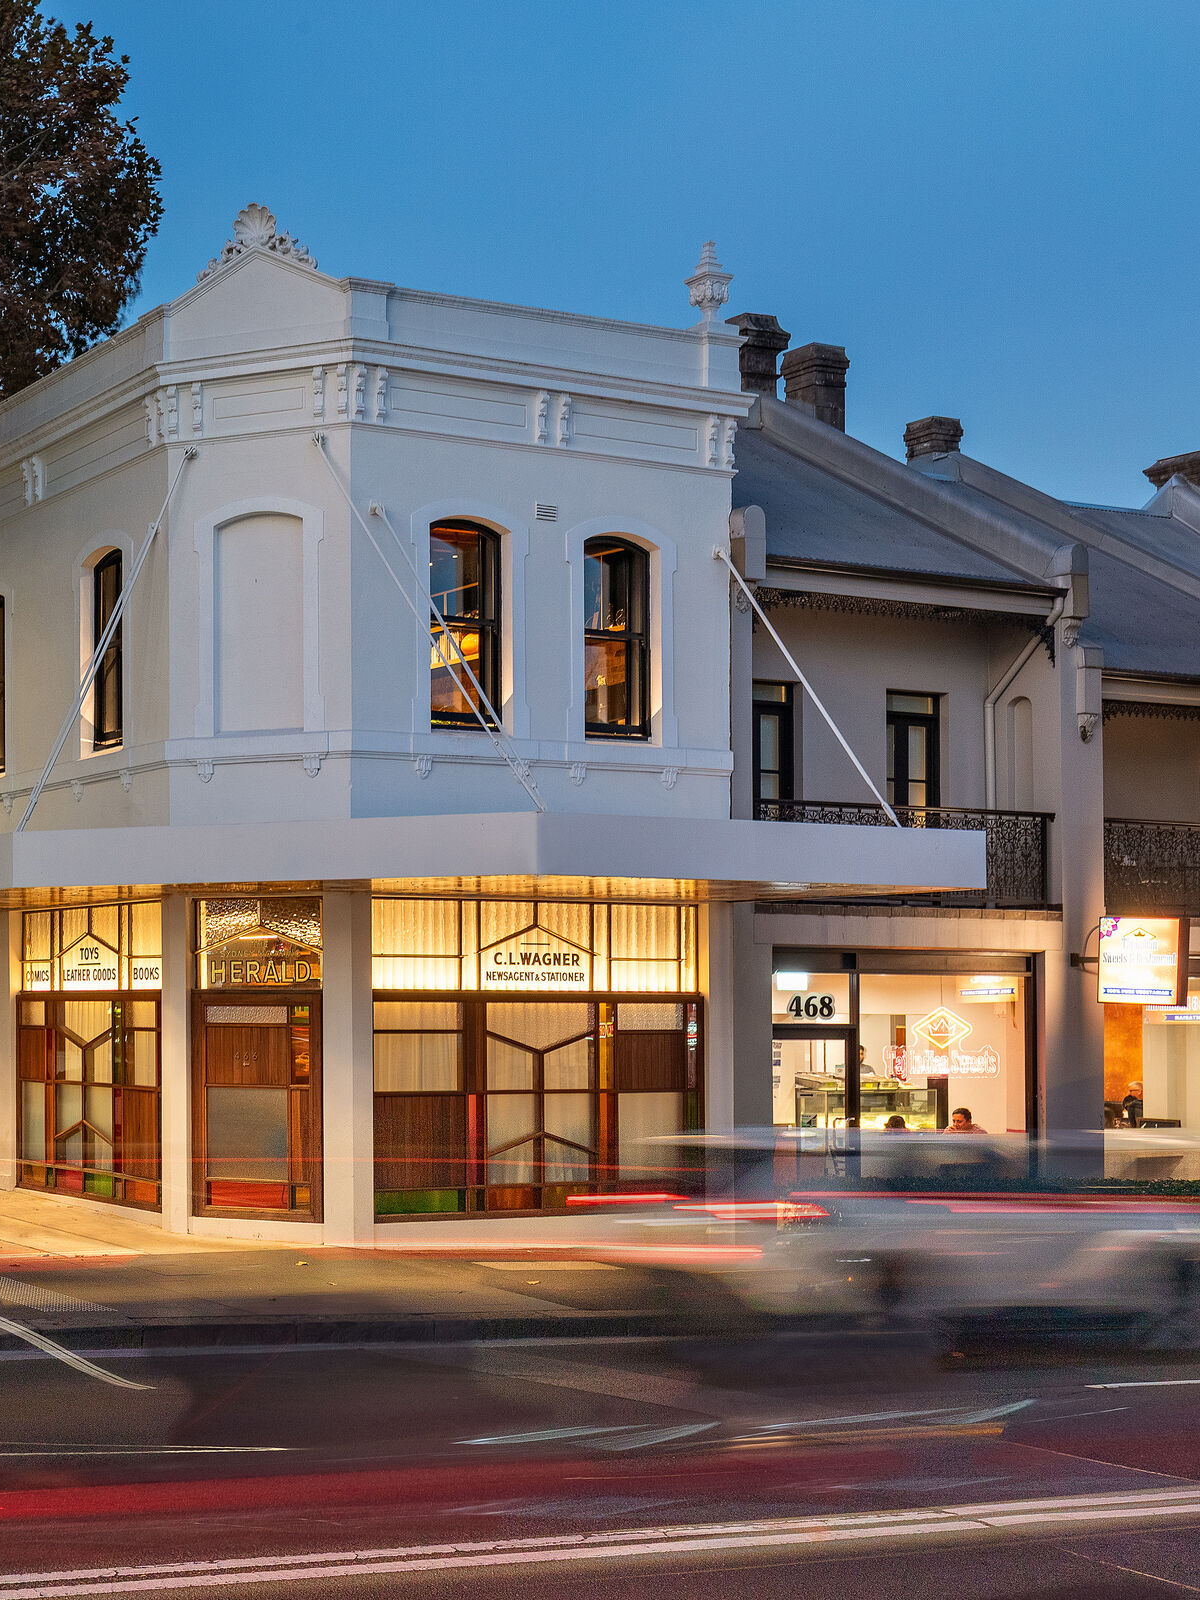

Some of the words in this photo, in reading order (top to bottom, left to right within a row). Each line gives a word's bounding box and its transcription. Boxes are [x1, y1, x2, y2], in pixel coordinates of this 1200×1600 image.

[79, 947, 99, 960] TOYS
[25, 970, 50, 982] COMICS
[63, 968, 91, 982] LEATHER
[92, 968, 117, 981] GOODS
[133, 967, 160, 981] BOOKS
[210, 960, 312, 984] HERALD
[788, 995, 834, 1017] 468
[909, 1049, 949, 1075] Indian
[950, 1048, 997, 1074] Sweets
